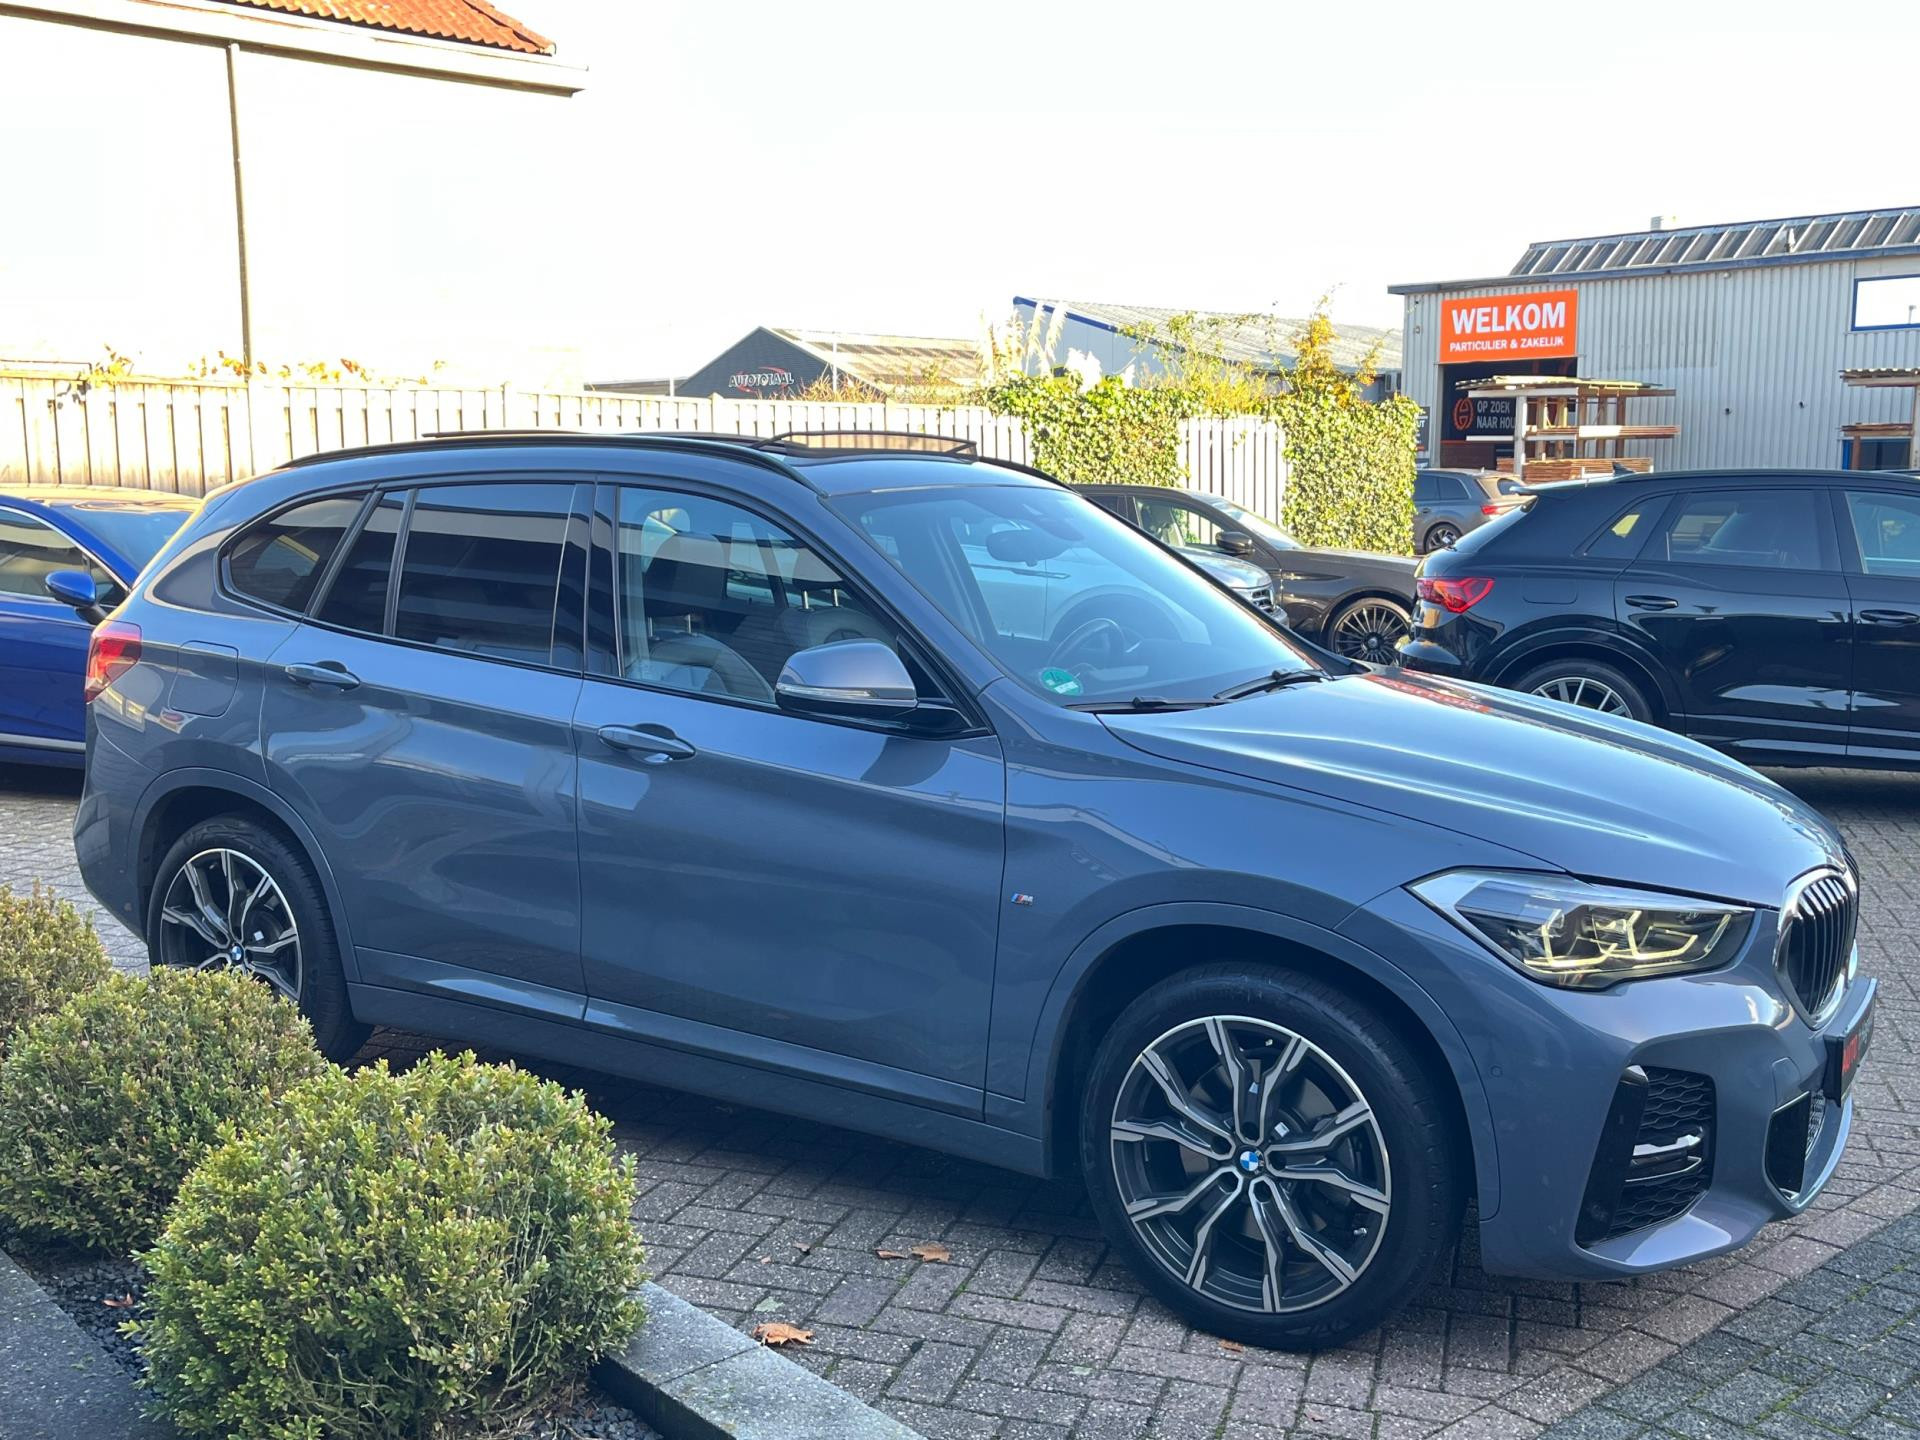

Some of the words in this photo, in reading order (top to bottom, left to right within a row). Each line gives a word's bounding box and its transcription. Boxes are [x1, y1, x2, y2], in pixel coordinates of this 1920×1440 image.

[1451, 301, 1565, 334] WELKOM
[1449, 340, 1507, 352] PARTICULIER
[1509, 339, 1519, 349] &
[1520, 336, 1564, 348] ZAKELIJK
[1477, 400, 1488, 413] OP
[1490, 400, 1510, 414] ZOEK
[1476, 415, 1499, 430] NAAR
[1499, 415, 1516, 430] HOU
